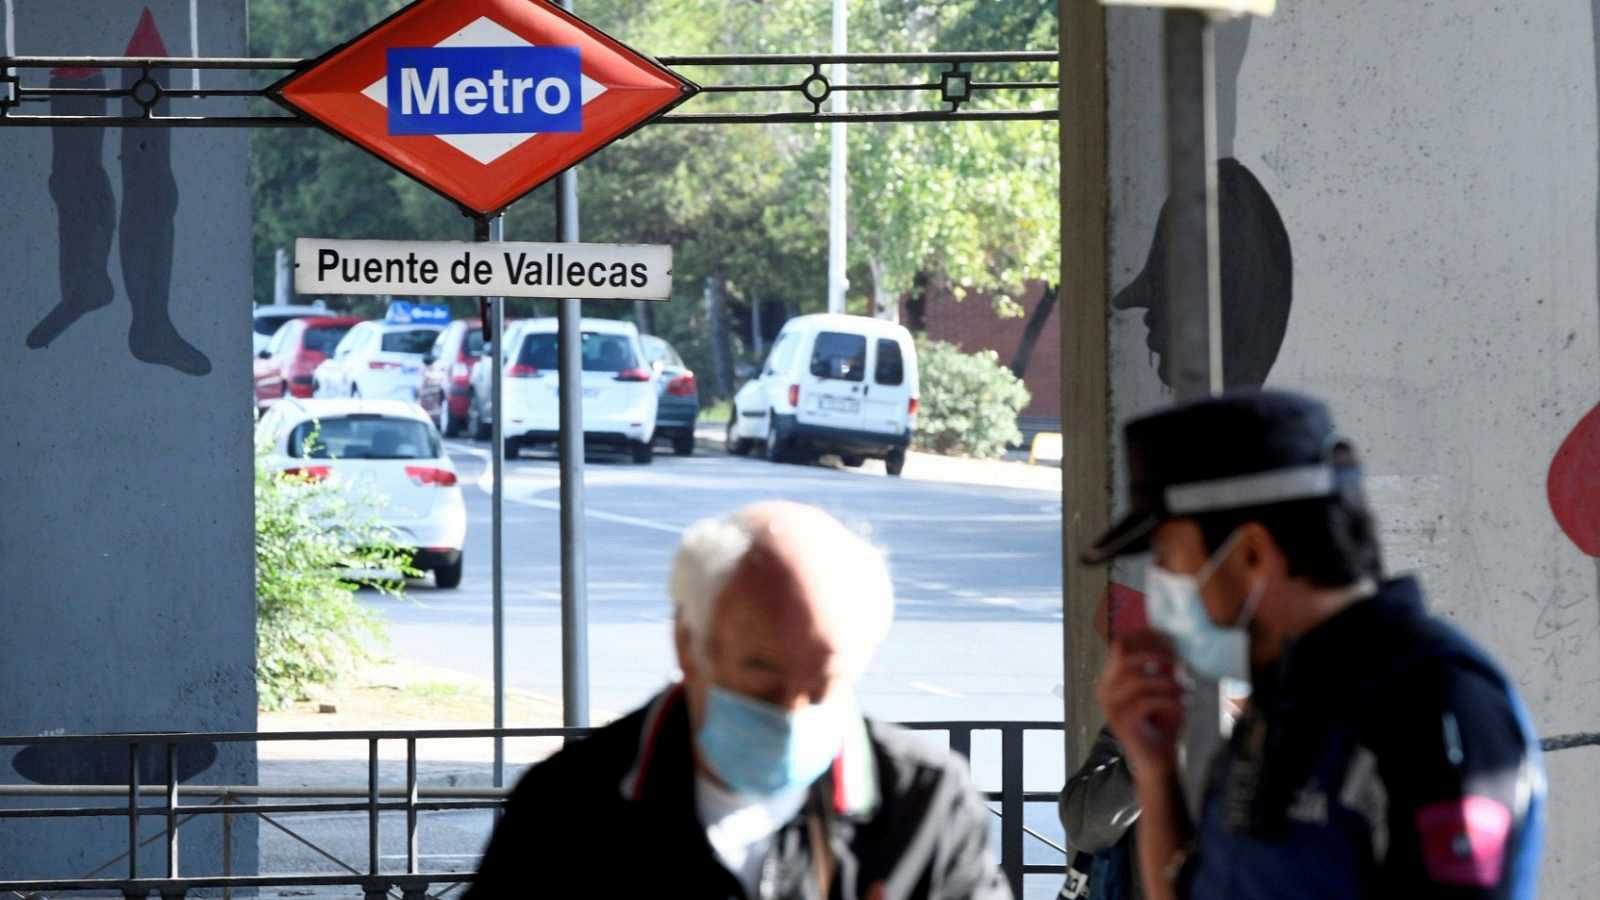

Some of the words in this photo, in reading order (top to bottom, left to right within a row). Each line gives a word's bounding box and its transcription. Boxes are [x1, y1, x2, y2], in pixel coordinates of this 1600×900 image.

[401, 67, 571, 115] Metro
[318, 248, 439, 285] Puente
[450, 251, 493, 286] de
[503, 253, 648, 288] Vallecas
